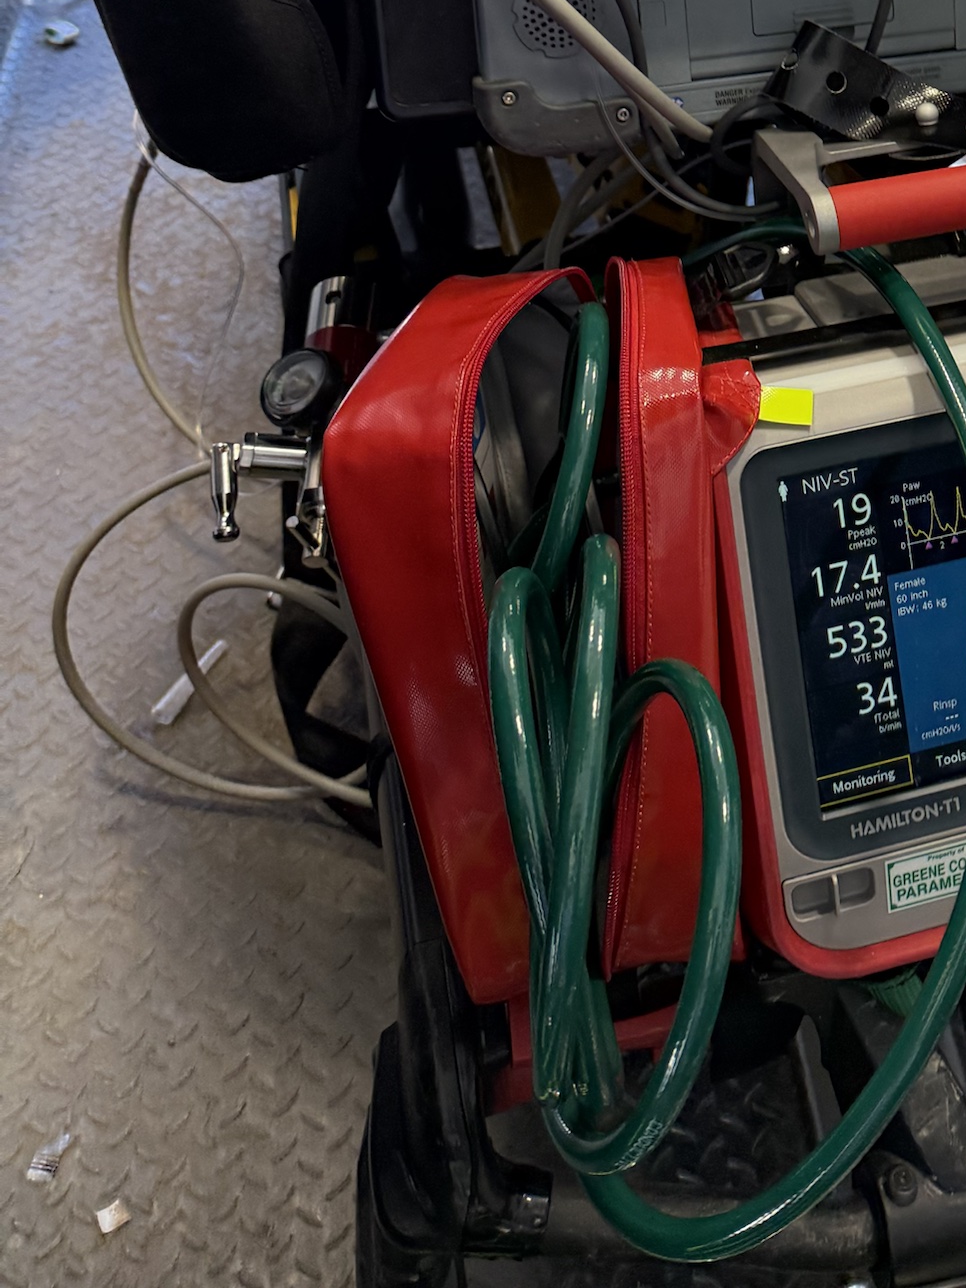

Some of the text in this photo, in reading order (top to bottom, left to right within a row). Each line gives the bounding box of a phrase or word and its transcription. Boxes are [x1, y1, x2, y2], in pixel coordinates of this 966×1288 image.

[802, 467, 858, 495] NIV-ST
[902, 481, 921, 493] Paw
[890, 495, 900, 505] 20
[833, 493, 872, 528] 19
[893, 518, 904, 528] 10
[847, 525, 877, 541] Ppeak
[848, 537, 878, 551] cmH2O
[900, 541, 906, 550] 0
[939, 540, 945, 550] 2
[811, 553, 881, 598] 17.4
[894, 576, 926, 592] Female
[830, 586, 884, 608] MinVol NIV
[896, 589, 929, 605] 60 inch
[922, 599, 933, 610] 46
[936, 596, 948, 610] kg
[826, 616, 888, 659] 533
[854, 647, 891, 665] VTE NIV
[856, 676, 898, 715] 34
[933, 698, 958, 712] Rinsp
[879, 721, 902, 734] b/min
[832, 769, 896, 795] Monitoring
[935, 749, 966, 768] Tools
[927, 846, 965, 861] Property of
[893, 863, 945, 887] GREENE
[896, 873, 962, 902] PARAME
